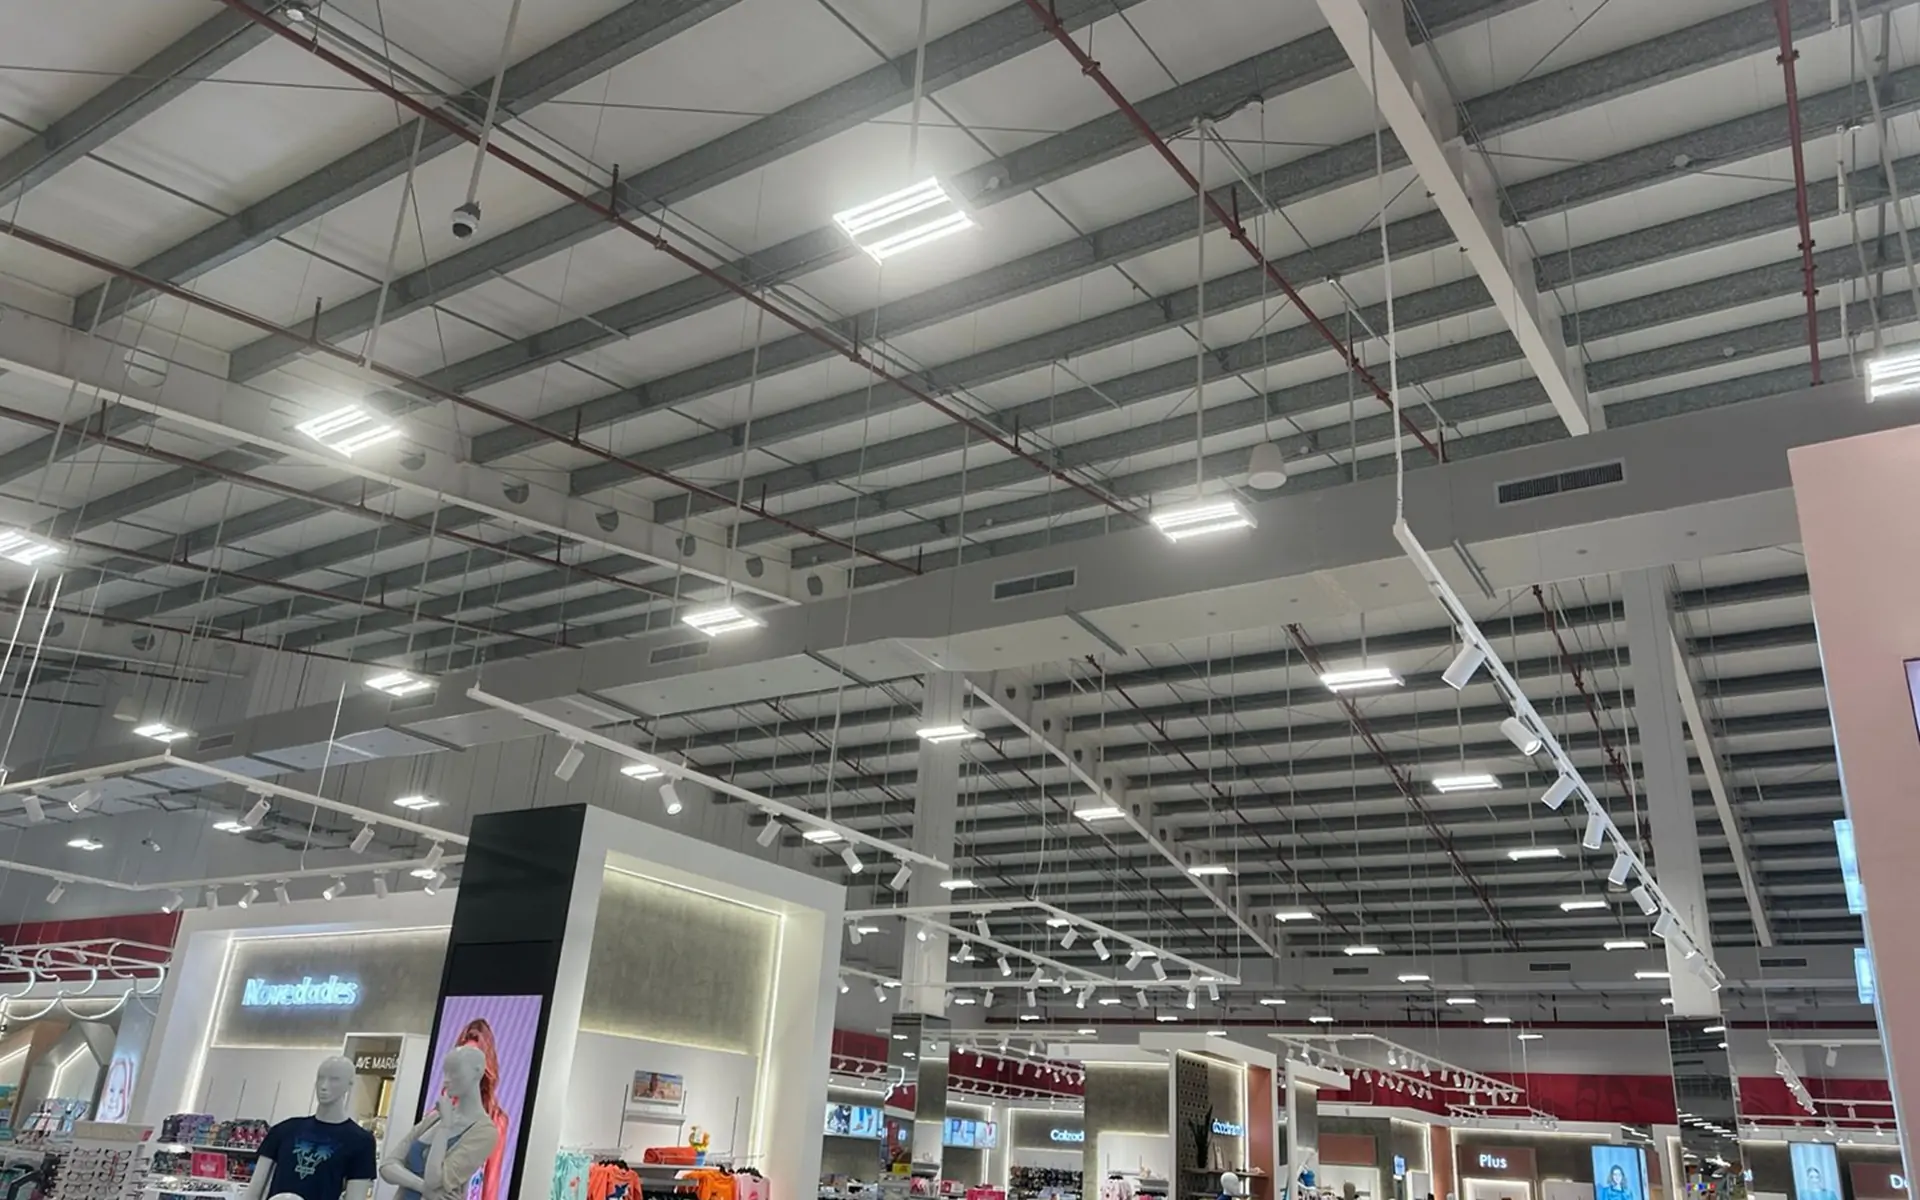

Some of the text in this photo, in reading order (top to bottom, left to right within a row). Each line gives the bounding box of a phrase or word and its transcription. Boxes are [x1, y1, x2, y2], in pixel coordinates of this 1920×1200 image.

[241, 975, 358, 1006] Novedades
[356, 1056, 371, 1069] AVE
[1479, 1153, 1508, 1169] Plus
